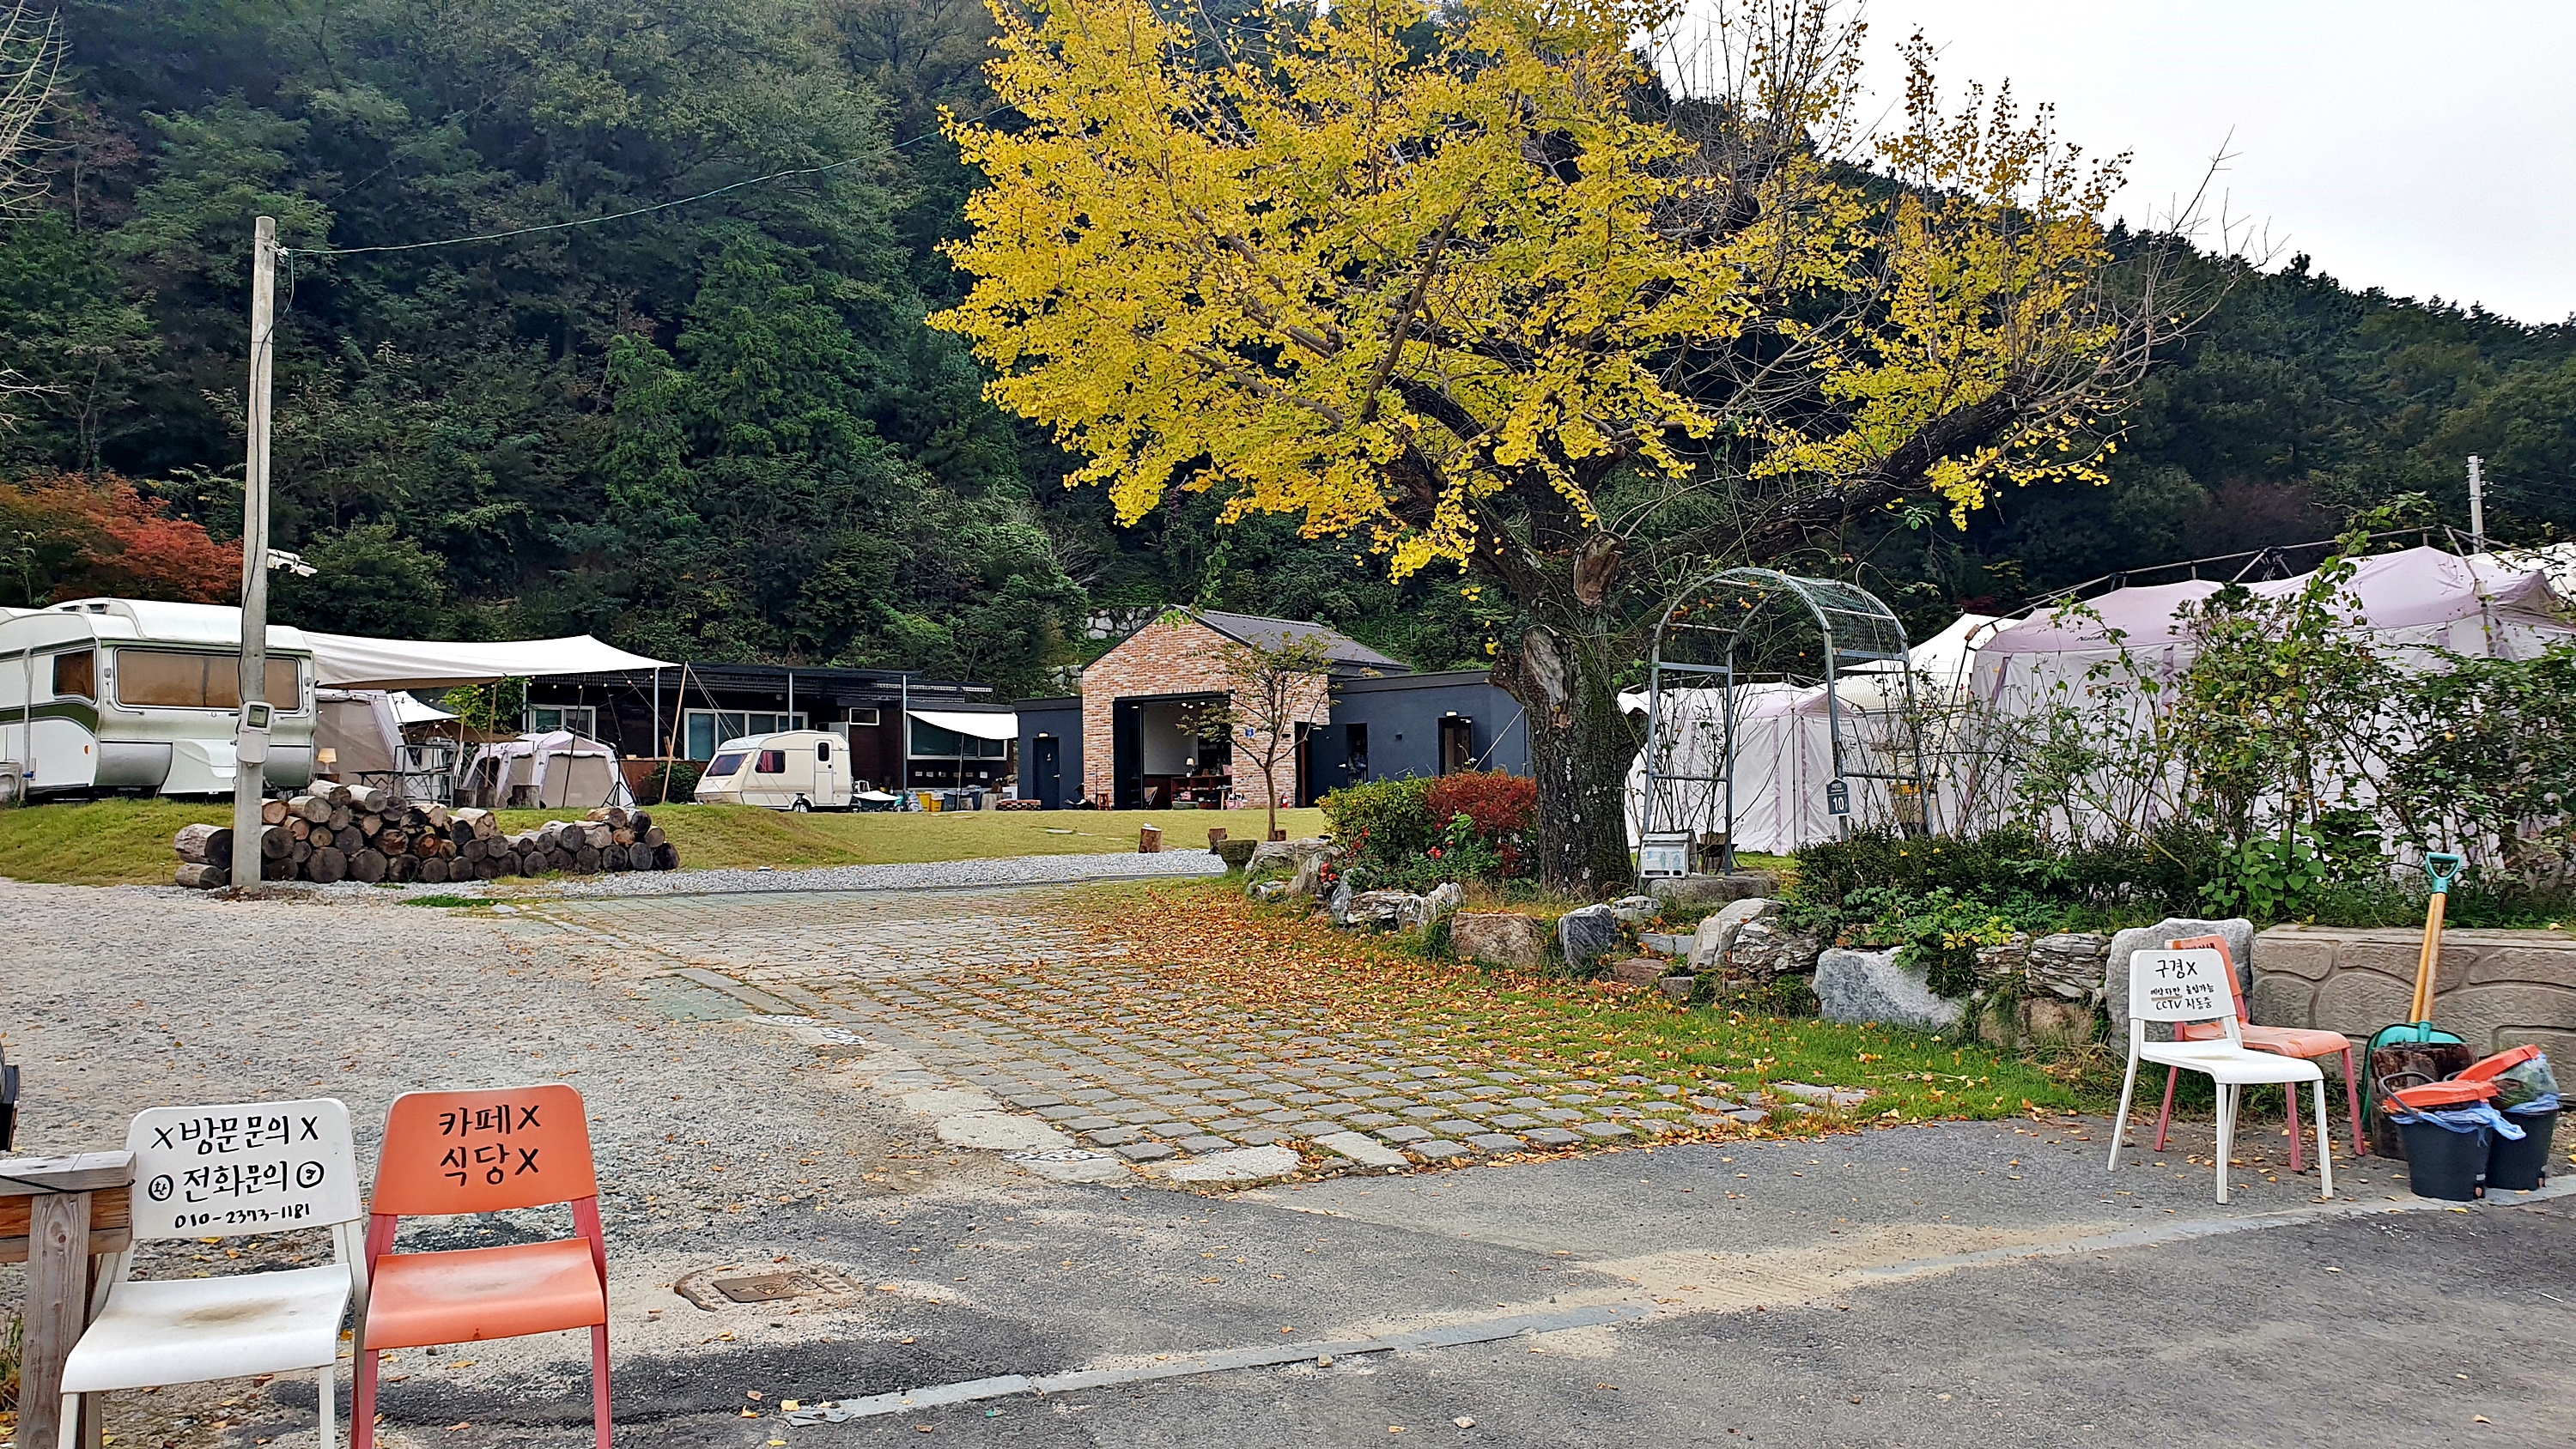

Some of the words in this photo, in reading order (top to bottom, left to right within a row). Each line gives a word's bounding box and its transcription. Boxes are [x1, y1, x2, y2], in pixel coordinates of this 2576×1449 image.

[1832, 796, 1844, 811] 10
[2155, 1000, 2182, 1011] CCTV
[183, 1161, 288, 1203] 전화문의
[174, 1203, 311, 1228] 010-2373-1181
